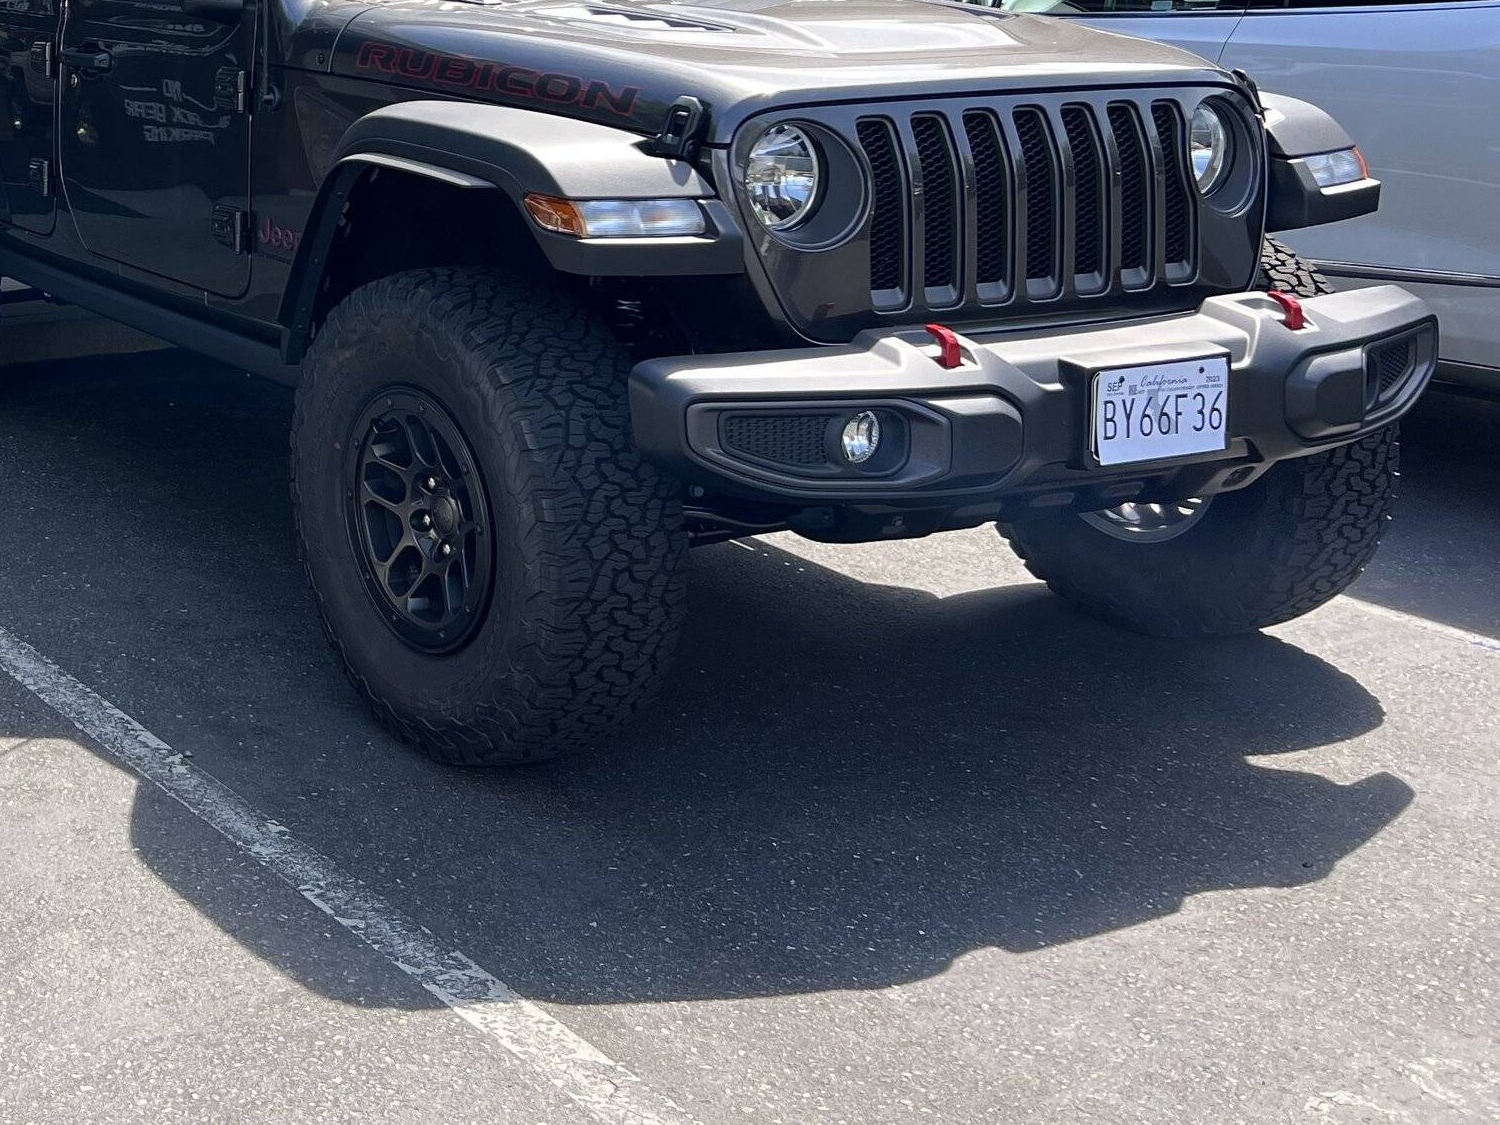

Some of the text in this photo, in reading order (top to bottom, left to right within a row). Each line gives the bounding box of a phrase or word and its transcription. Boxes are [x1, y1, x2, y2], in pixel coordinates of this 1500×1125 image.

[356, 41, 643, 117] RUBICON
[1106, 381, 1123, 392] SEP
[1140, 374, 1188, 388] California
[1103, 390, 1223, 441] BY66F36
